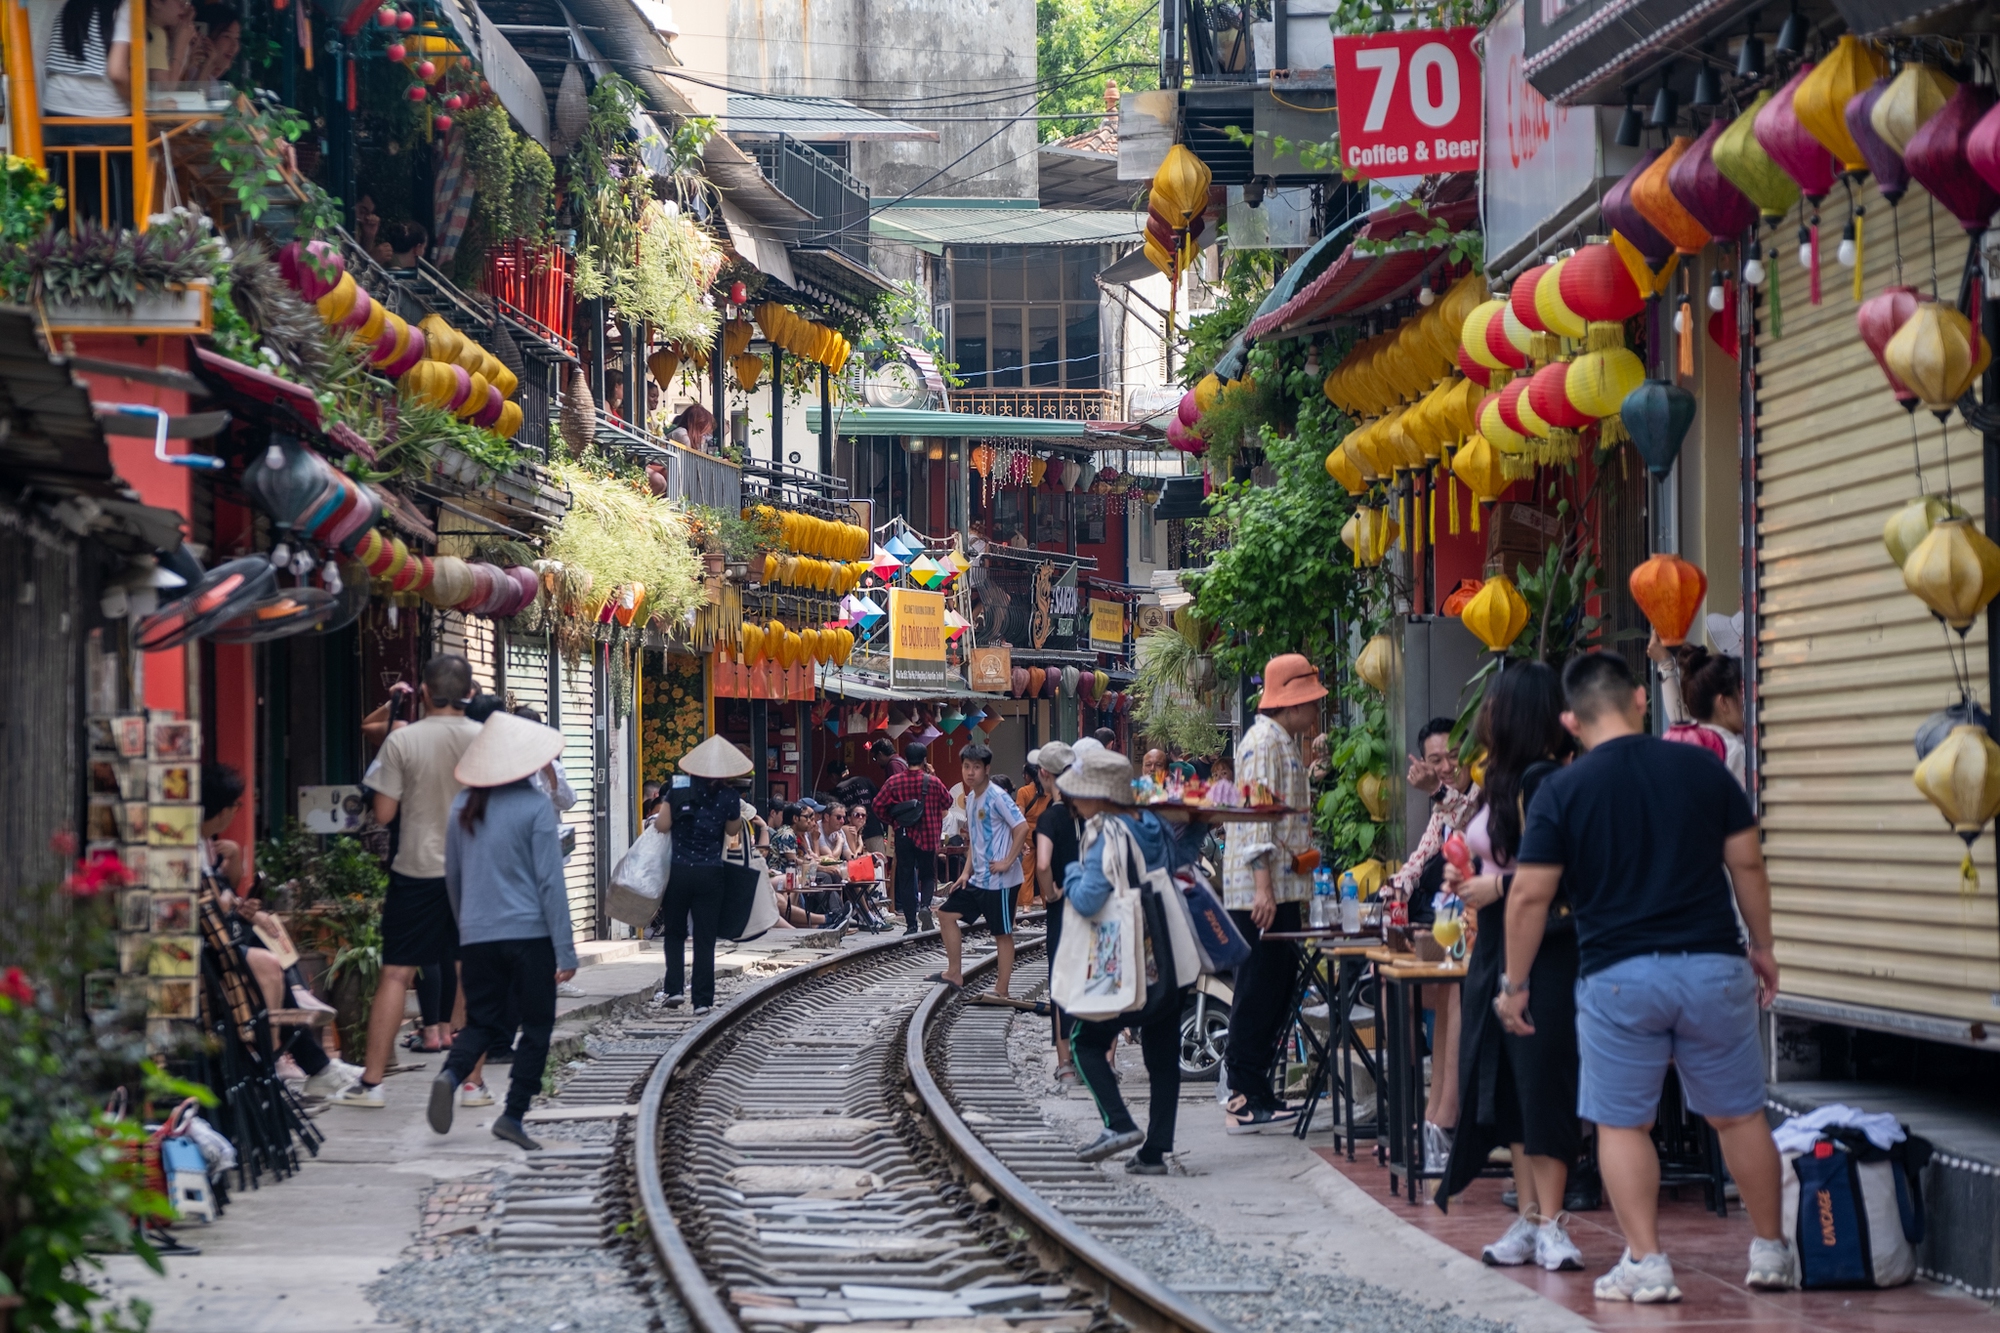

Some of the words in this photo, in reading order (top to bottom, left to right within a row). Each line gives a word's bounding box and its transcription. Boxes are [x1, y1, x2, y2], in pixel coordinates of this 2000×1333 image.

[1356, 42, 1460, 132] 70
[1348, 143, 1409, 167] Coffee
[1415, 140, 1429, 161] &
[1434, 138, 1479, 160] Beer
[1817, 1189, 1836, 1247] UNCAGE
